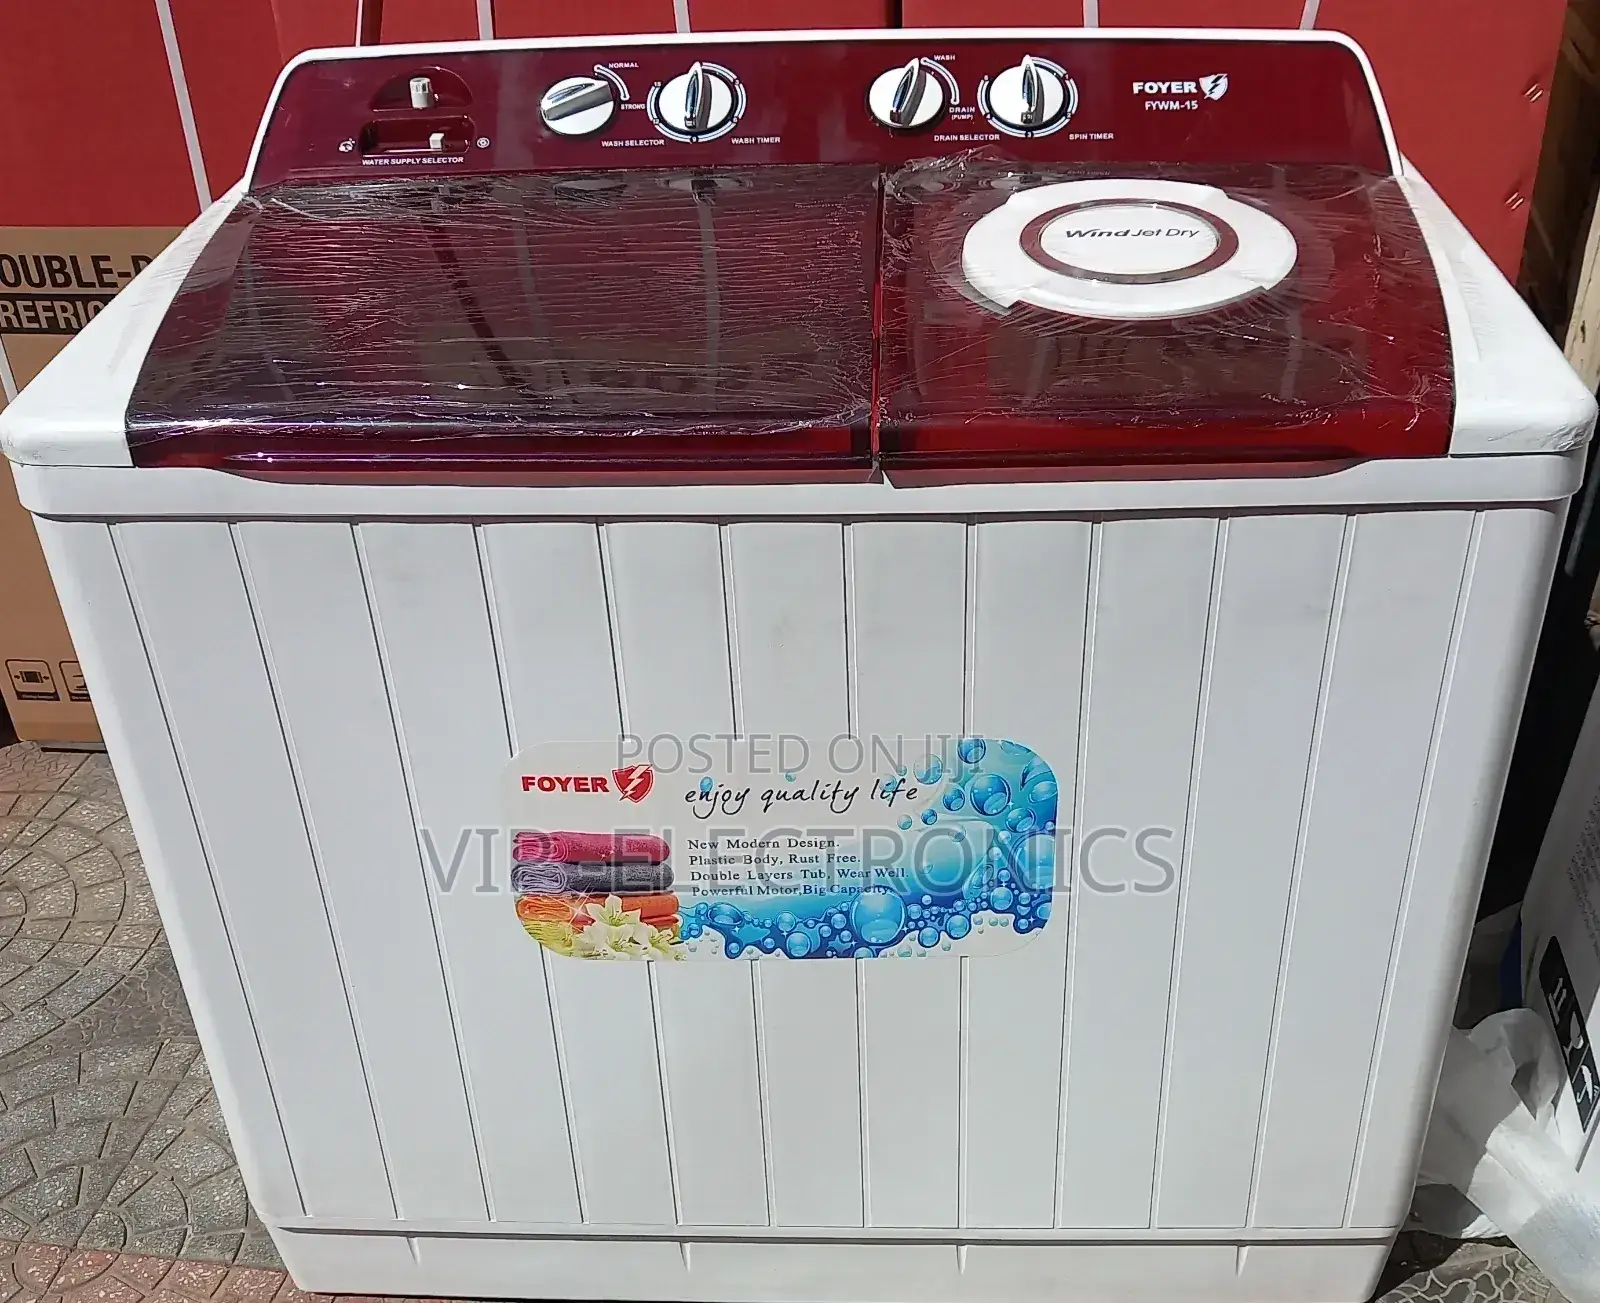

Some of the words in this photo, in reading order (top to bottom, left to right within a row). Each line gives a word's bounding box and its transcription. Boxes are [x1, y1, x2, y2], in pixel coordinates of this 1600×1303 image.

[1132, 82, 1198, 94] FOYER
[1144, 100, 1199, 111] FYWM-15
[624, 139, 665, 147] SELECTOR
[421, 156, 464, 164] SELECTOR
[1165, 228, 1200, 238] Dry
[521, 776, 609, 793] FOYER
[685, 783, 751, 819] enjoy
[761, 779, 859, 814] quality
[870, 778, 919, 808] life
[687, 839, 719, 850] New
[726, 838, 780, 850] Modern
[787, 837, 840, 850] Design.
[689, 855, 736, 866] Plastic
[743, 854, 784, 867] Body,
[788, 854, 820, 864] Rust
[826, 853, 861, 864] Free.
[691, 870, 740, 881] Double
[747, 870, 793, 882] Layers
[800, 869, 831, 880] Tub,
[837, 868, 871, 879] Wear
[874, 868, 909, 878] Well.
[692, 885, 753, 897] Powerful
[829, 884, 894, 897] Capacity.
